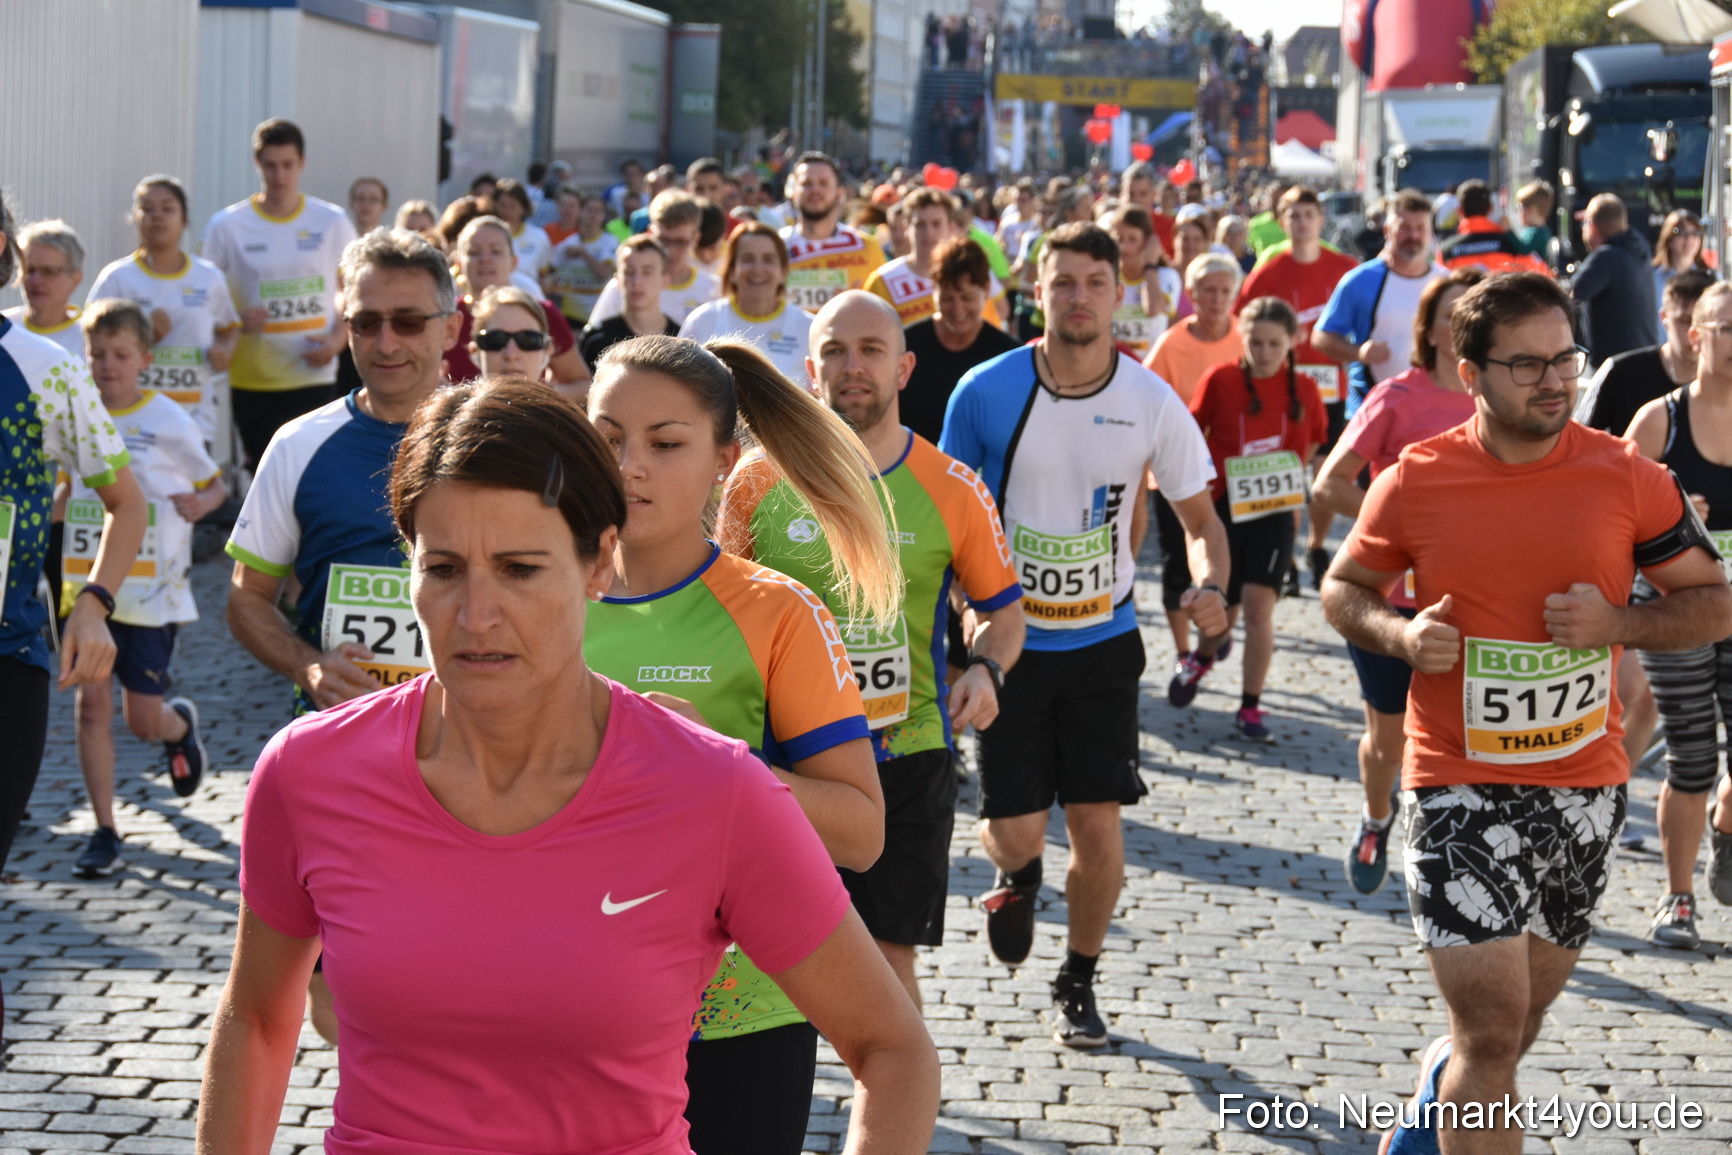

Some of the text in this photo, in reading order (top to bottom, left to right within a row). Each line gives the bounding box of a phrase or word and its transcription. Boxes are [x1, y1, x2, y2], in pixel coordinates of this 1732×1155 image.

[1063, 82, 1130, 98] START
[267, 296, 320, 318] 5246
[1237, 473, 1293, 499] 5191
[1018, 529, 1105, 563] BOCK
[1021, 563, 1101, 596] 5051
[1023, 600, 1099, 618] ANDREAS
[342, 614, 423, 658] 521
[637, 665, 712, 682] BOCK
[1478, 645, 1606, 677] BOCK
[1483, 673, 1595, 723] 5172
[1498, 722, 1585, 750] THALES
